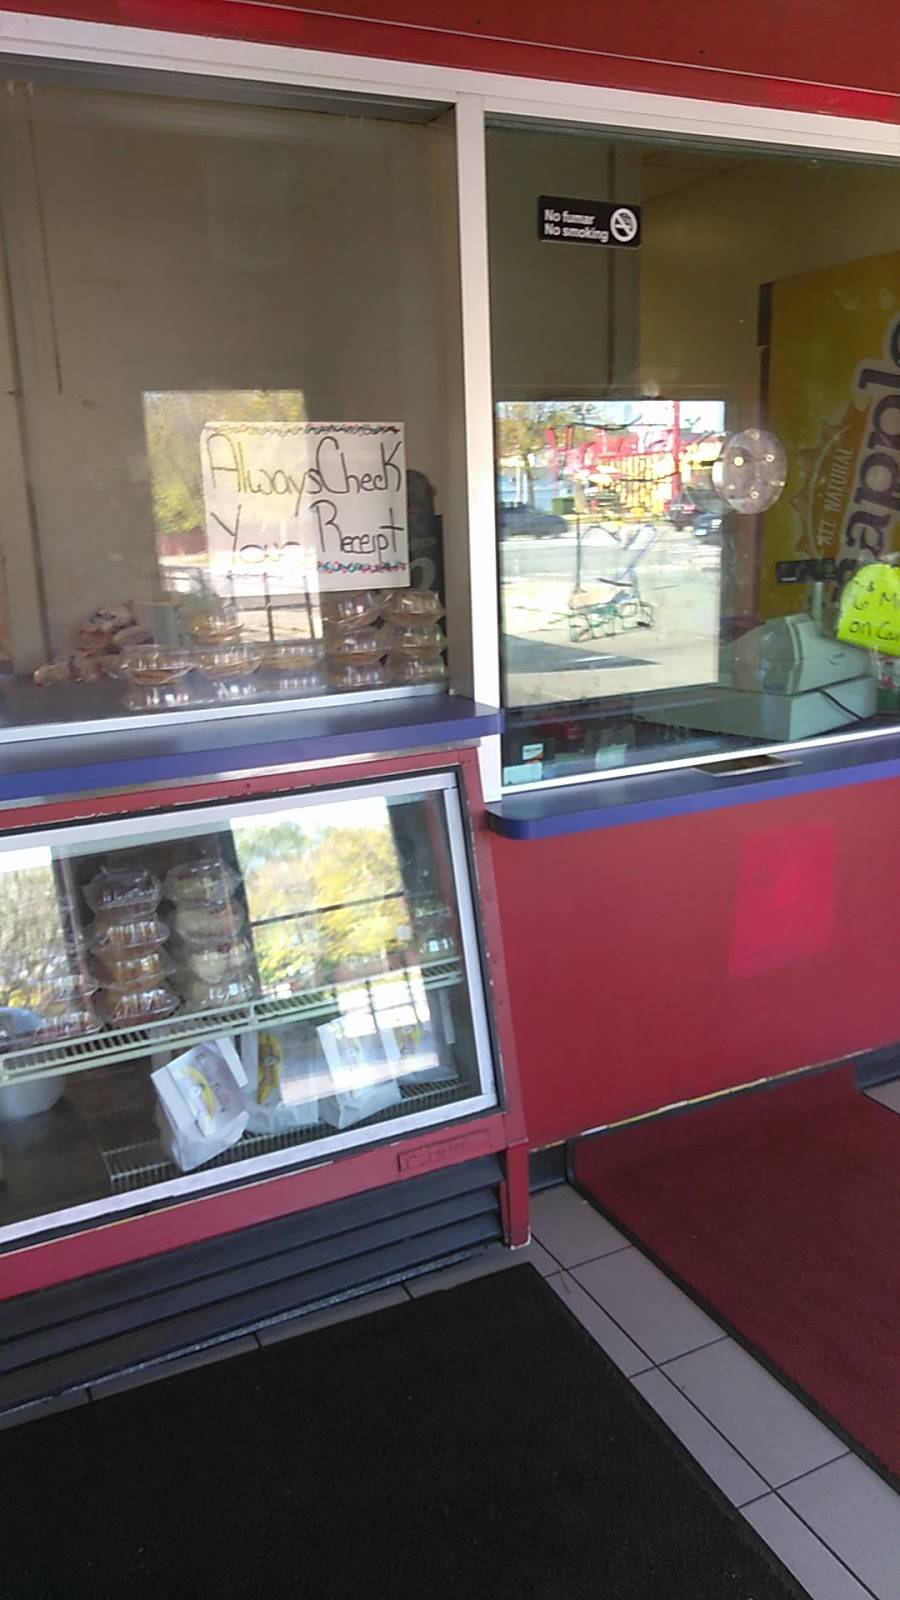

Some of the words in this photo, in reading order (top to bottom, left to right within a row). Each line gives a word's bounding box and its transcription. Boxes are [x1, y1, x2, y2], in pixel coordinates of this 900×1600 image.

[543, 208, 561, 222] No
[562, 211, 596, 225] fumar
[543, 223, 561, 236] No
[562, 226, 609, 243] smoking
[206, 433, 322, 517] Always
